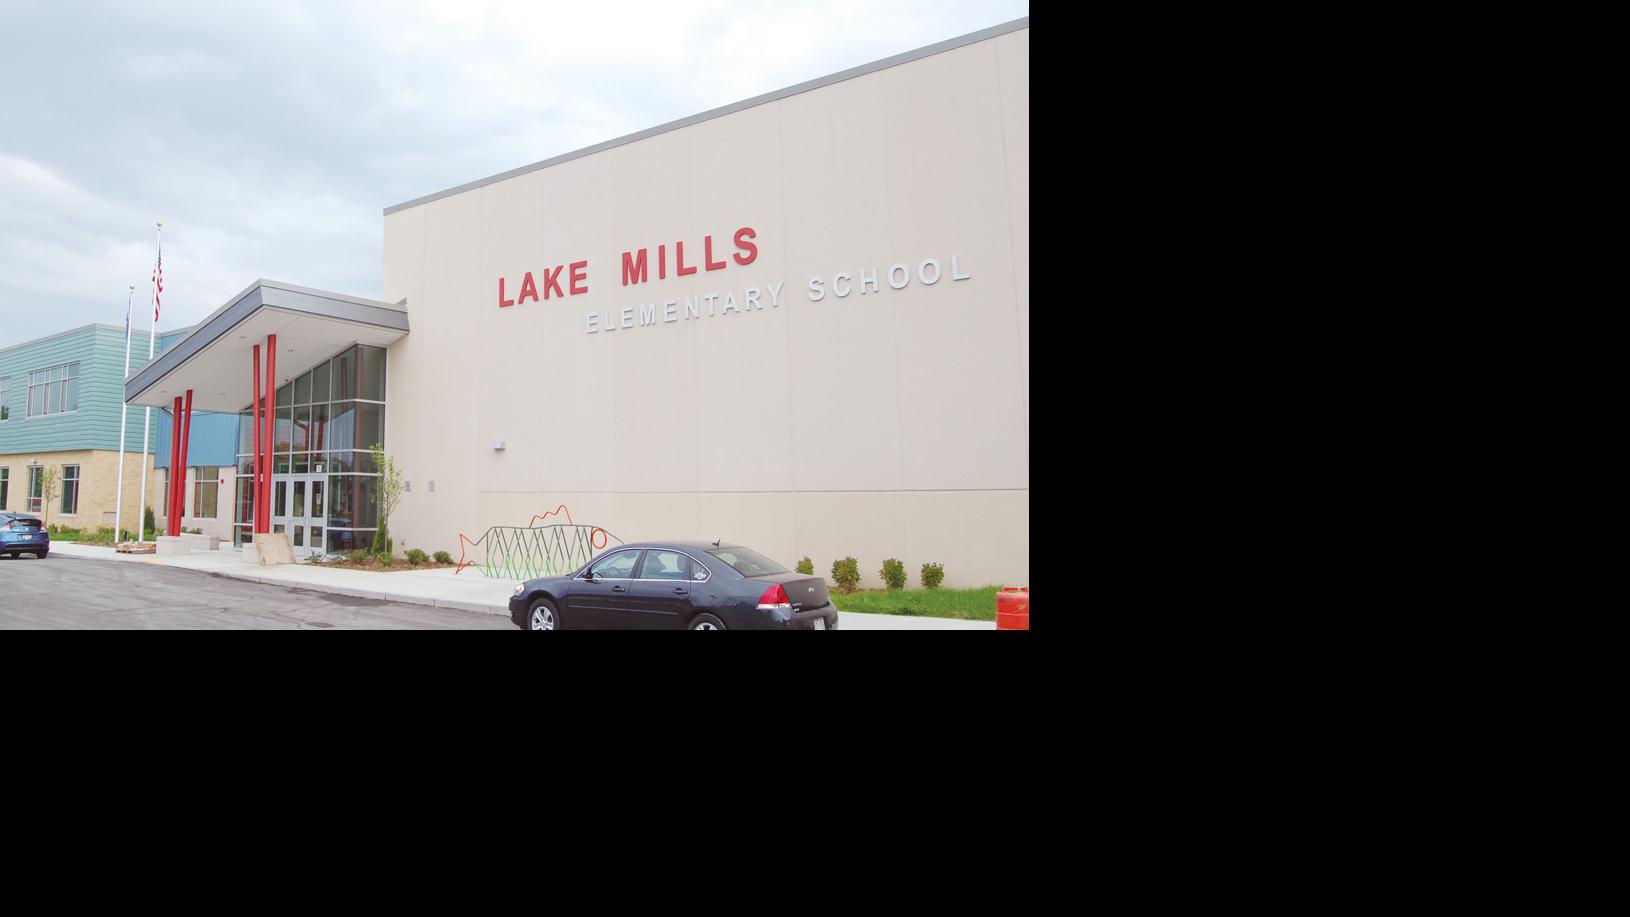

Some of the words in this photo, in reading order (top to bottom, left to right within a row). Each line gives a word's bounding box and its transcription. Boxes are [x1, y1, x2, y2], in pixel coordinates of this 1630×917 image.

[499, 260, 588, 308] LAKE
[621, 227, 758, 286] MILLS
[586, 282, 783, 334] ELEMENTARY
[807, 254, 971, 302] SCHOOL
